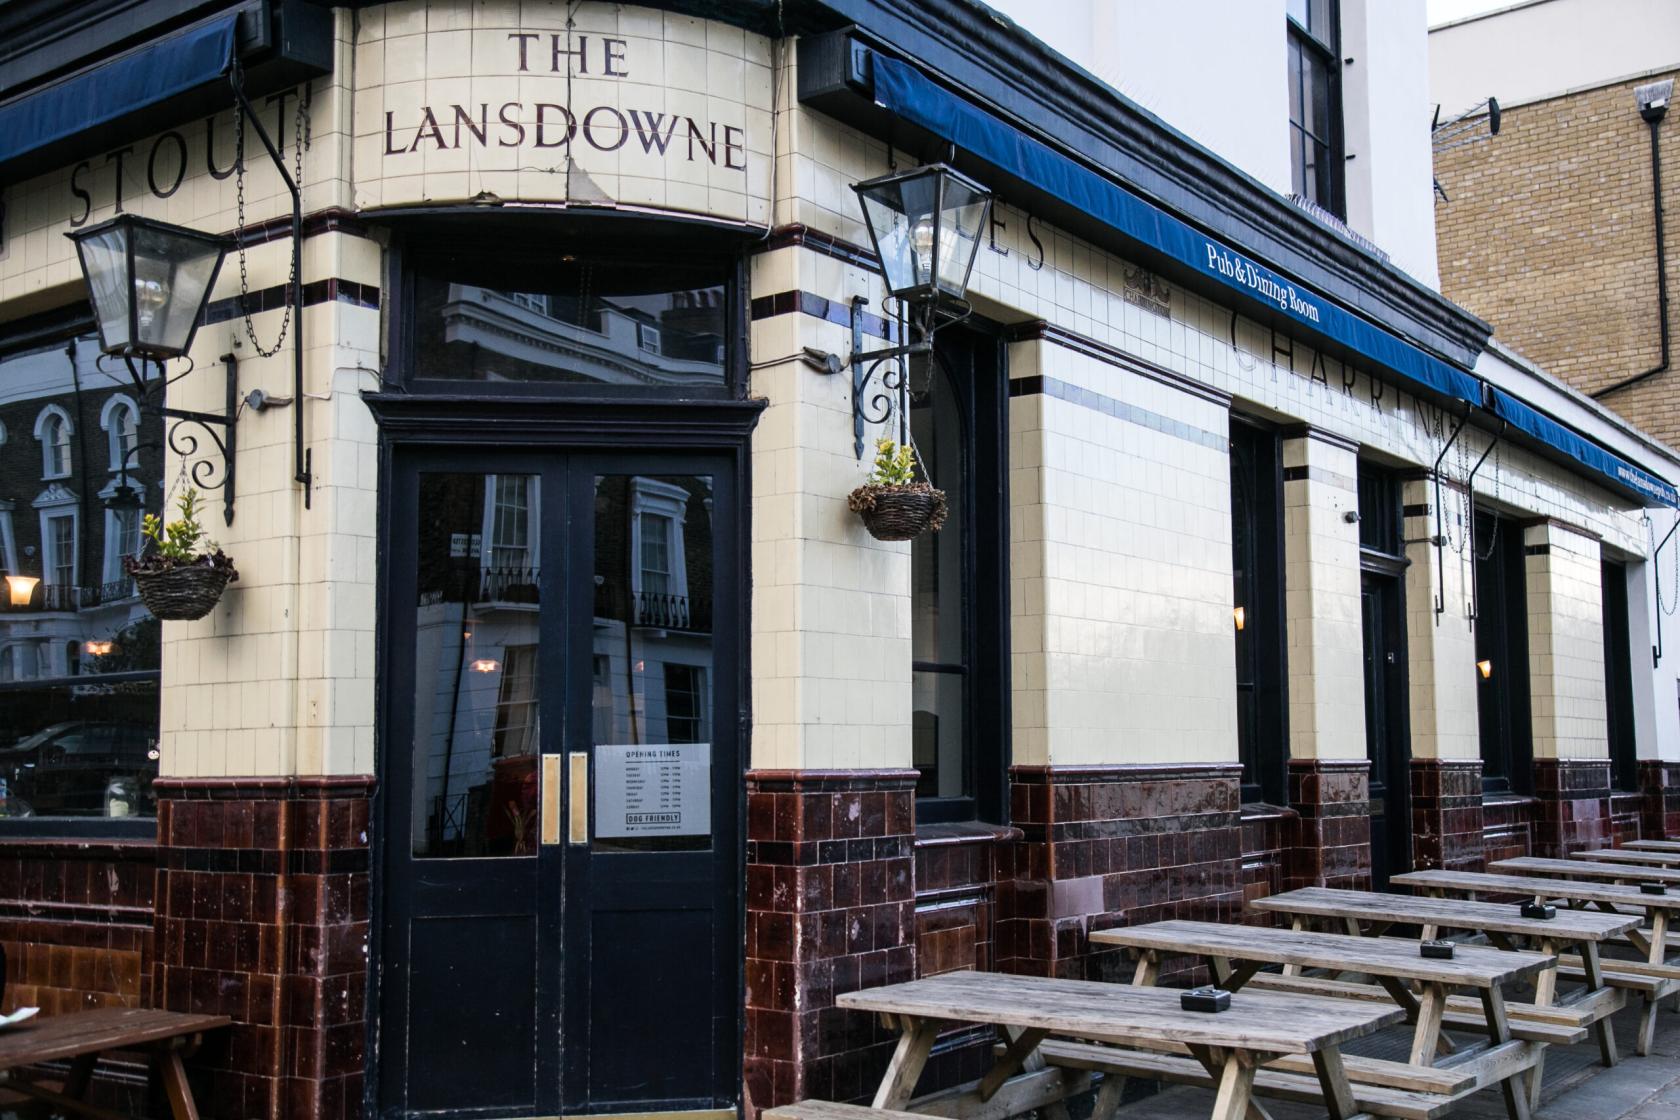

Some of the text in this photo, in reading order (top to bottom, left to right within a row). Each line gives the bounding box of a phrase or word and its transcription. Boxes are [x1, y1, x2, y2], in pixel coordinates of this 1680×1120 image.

[508, 33, 629, 77] THE
[70, 87, 299, 227] STOUT
[384, 101, 748, 172] LANSDOWNE
[1206, 243, 1234, 277] Pub
[1245, 262, 1288, 310] Dining
[1287, 285, 1320, 322] Room
[645, 814, 678, 822] FRIENDLY
